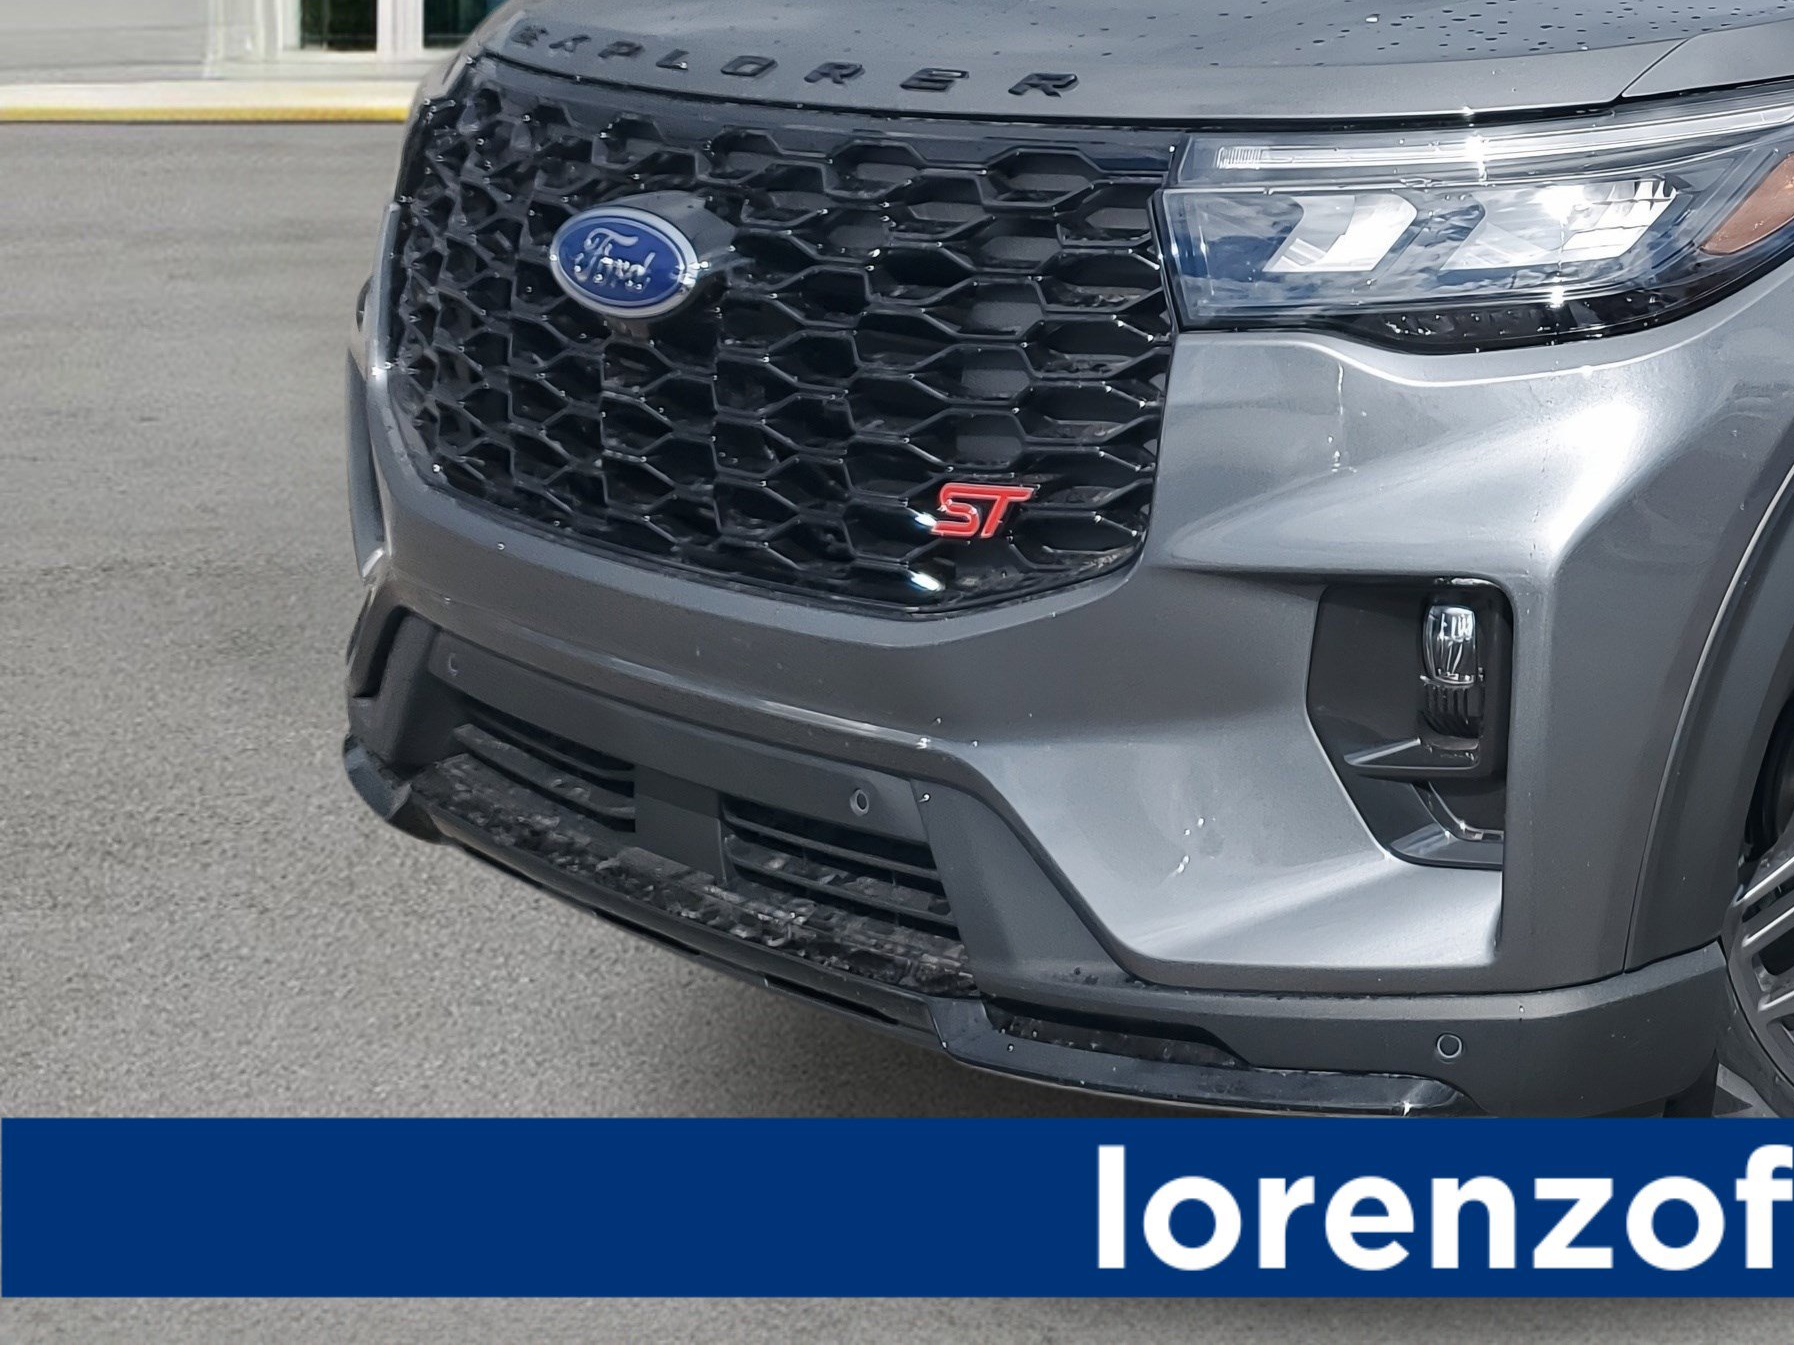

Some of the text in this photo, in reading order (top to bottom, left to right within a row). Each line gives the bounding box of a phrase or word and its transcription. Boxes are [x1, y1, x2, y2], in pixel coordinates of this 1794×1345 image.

[510, 25, 1080, 98] EXPLORER
[574, 227, 656, 293] Ford
[930, 482, 1035, 538] ST
